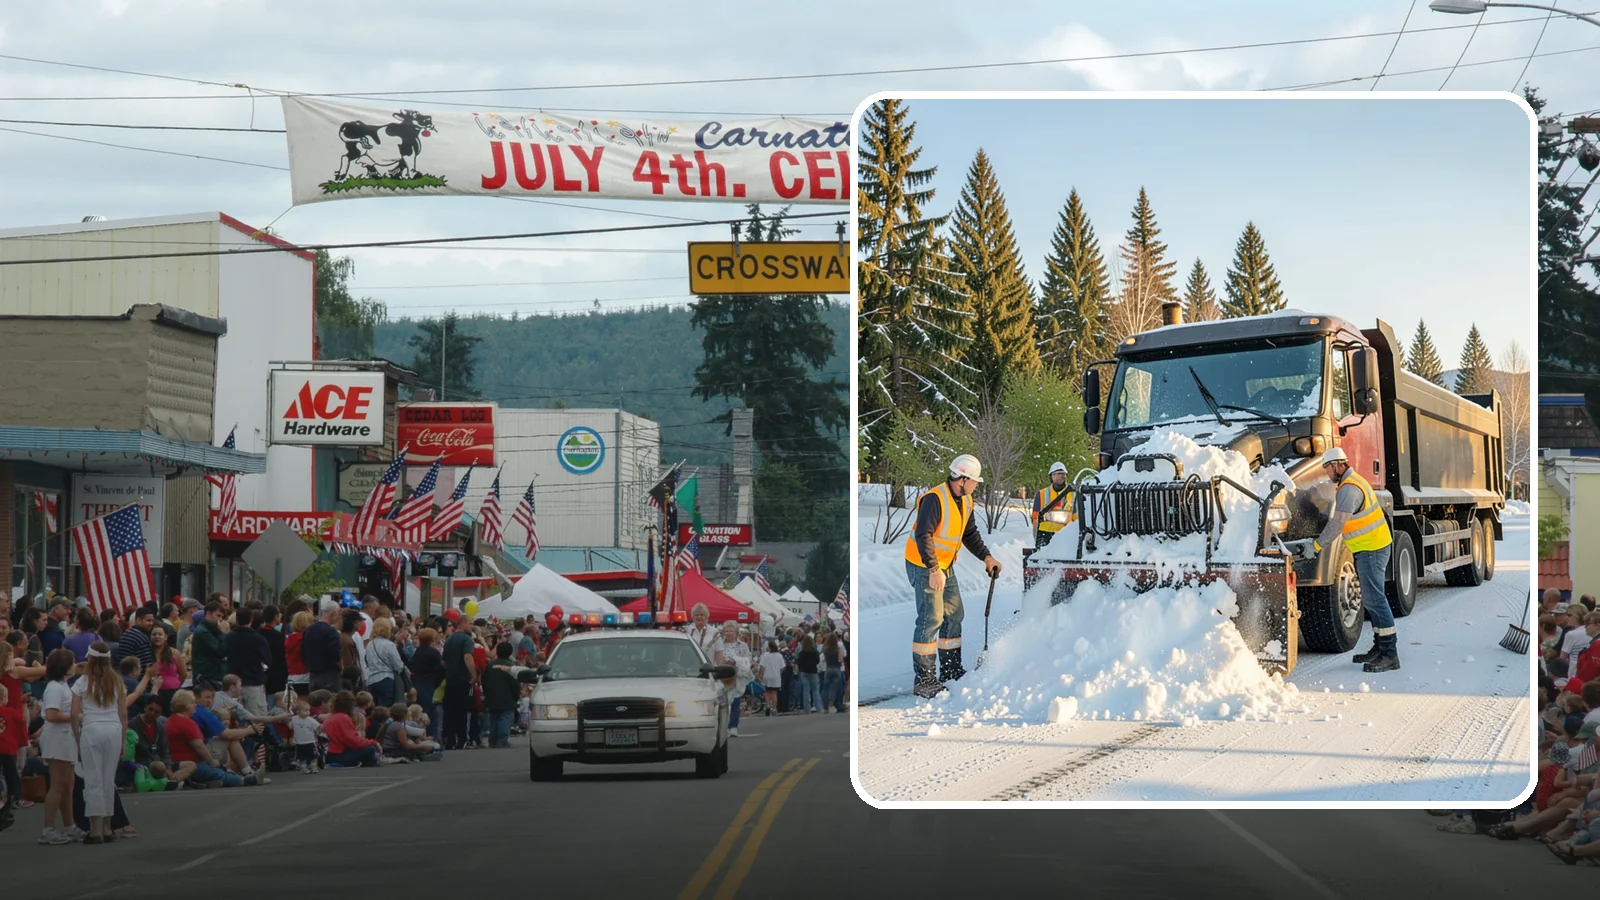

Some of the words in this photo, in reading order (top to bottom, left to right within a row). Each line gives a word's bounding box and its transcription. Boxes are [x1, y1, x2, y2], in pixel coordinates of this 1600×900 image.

[695, 121, 850, 150] Carnat
[481, 141, 605, 192] JULY
[632, 150, 746, 197] 4th.
[697, 254, 850, 279] CROSSWA
[283, 380, 373, 420] ACE
[405, 409, 453, 422] CEDAR
[462, 409, 485, 421] LOG
[284, 421, 371, 436] Hardware
[416, 428, 477, 447] Coca-Cola
[353, 467, 387, 480] Simpl
[83, 485, 93, 494] St.
[96, 485, 124, 495] Vincent
[126, 486, 135, 495] de
[138, 486, 155, 495] Paul
[688, 527, 741, 535] CRNATION
[699, 535, 730, 543] GLASS
